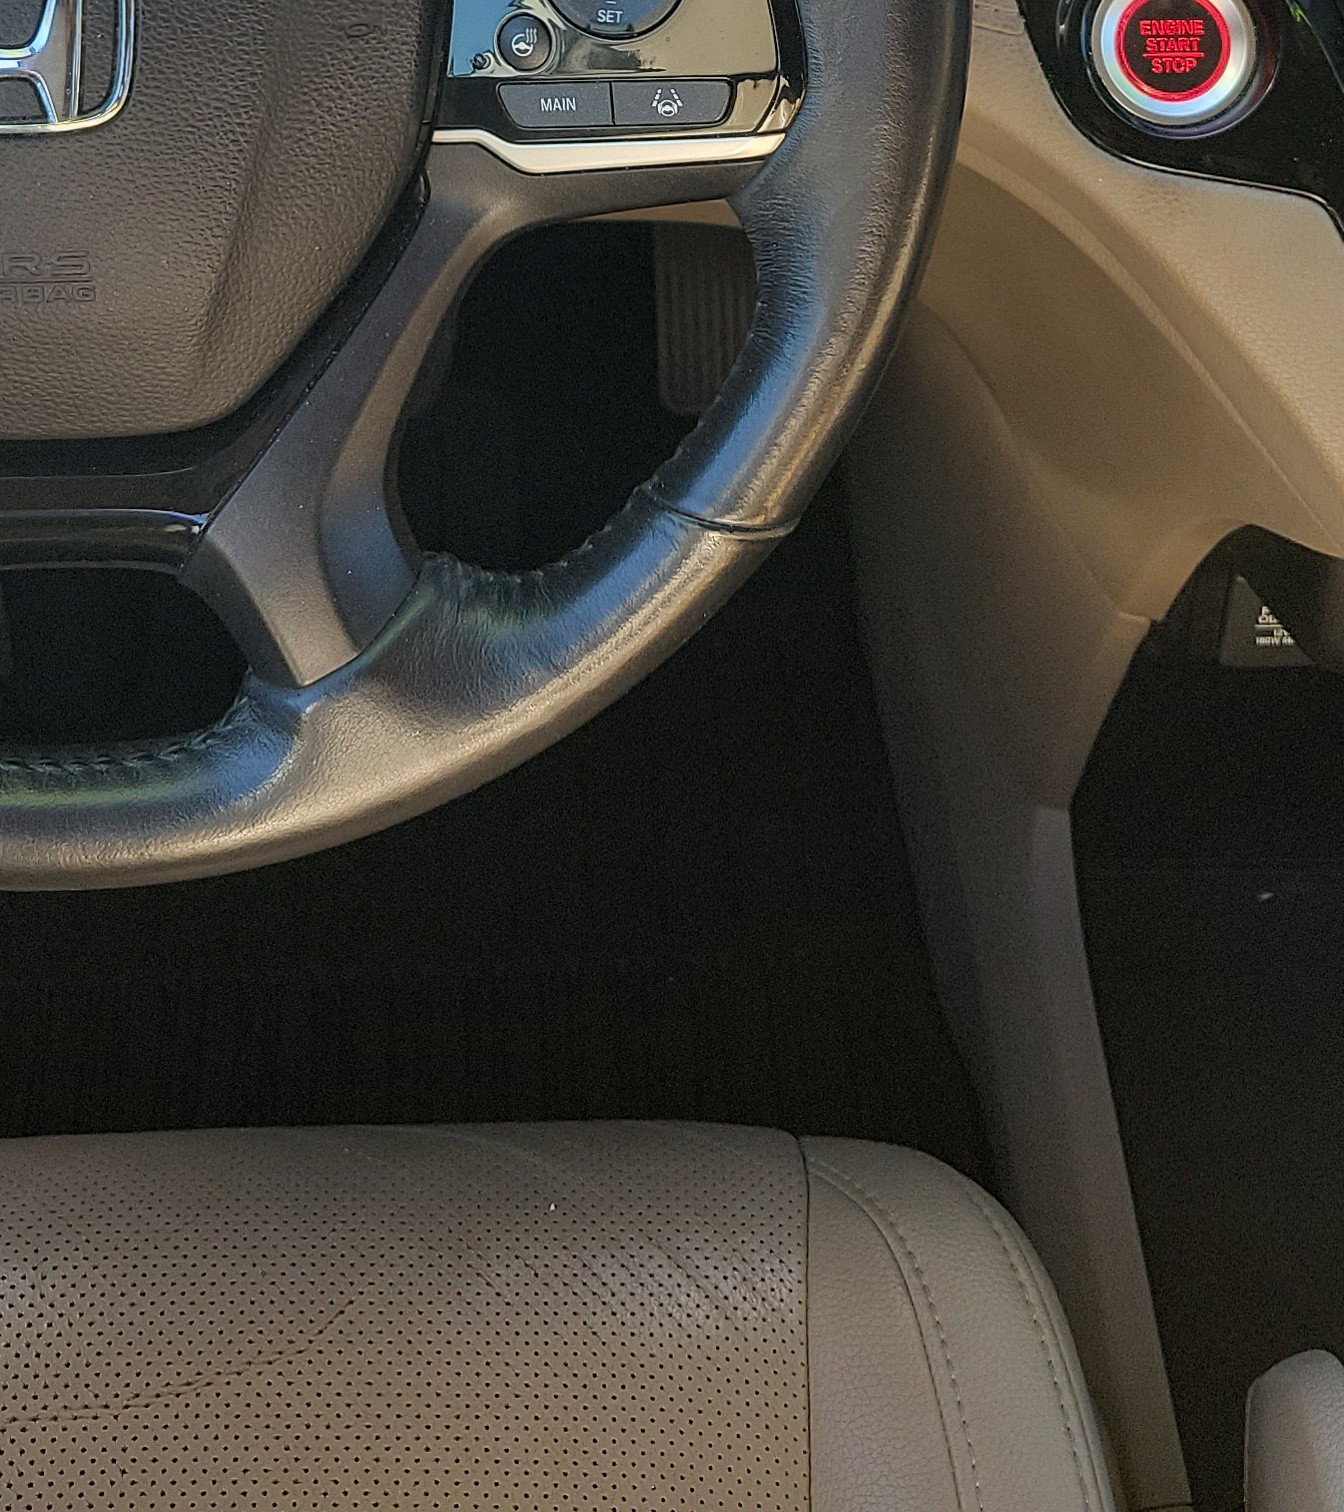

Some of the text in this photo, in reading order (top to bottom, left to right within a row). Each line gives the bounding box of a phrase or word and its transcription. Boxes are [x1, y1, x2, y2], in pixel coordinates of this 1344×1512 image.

[597, 10, 623, 23] SET
[1139, 19, 1205, 36] ENGINE
[1145, 37, 1201, 52] START
[1151, 57, 1197, 74] STOP
[540, 96, 576, 113] MAIN
